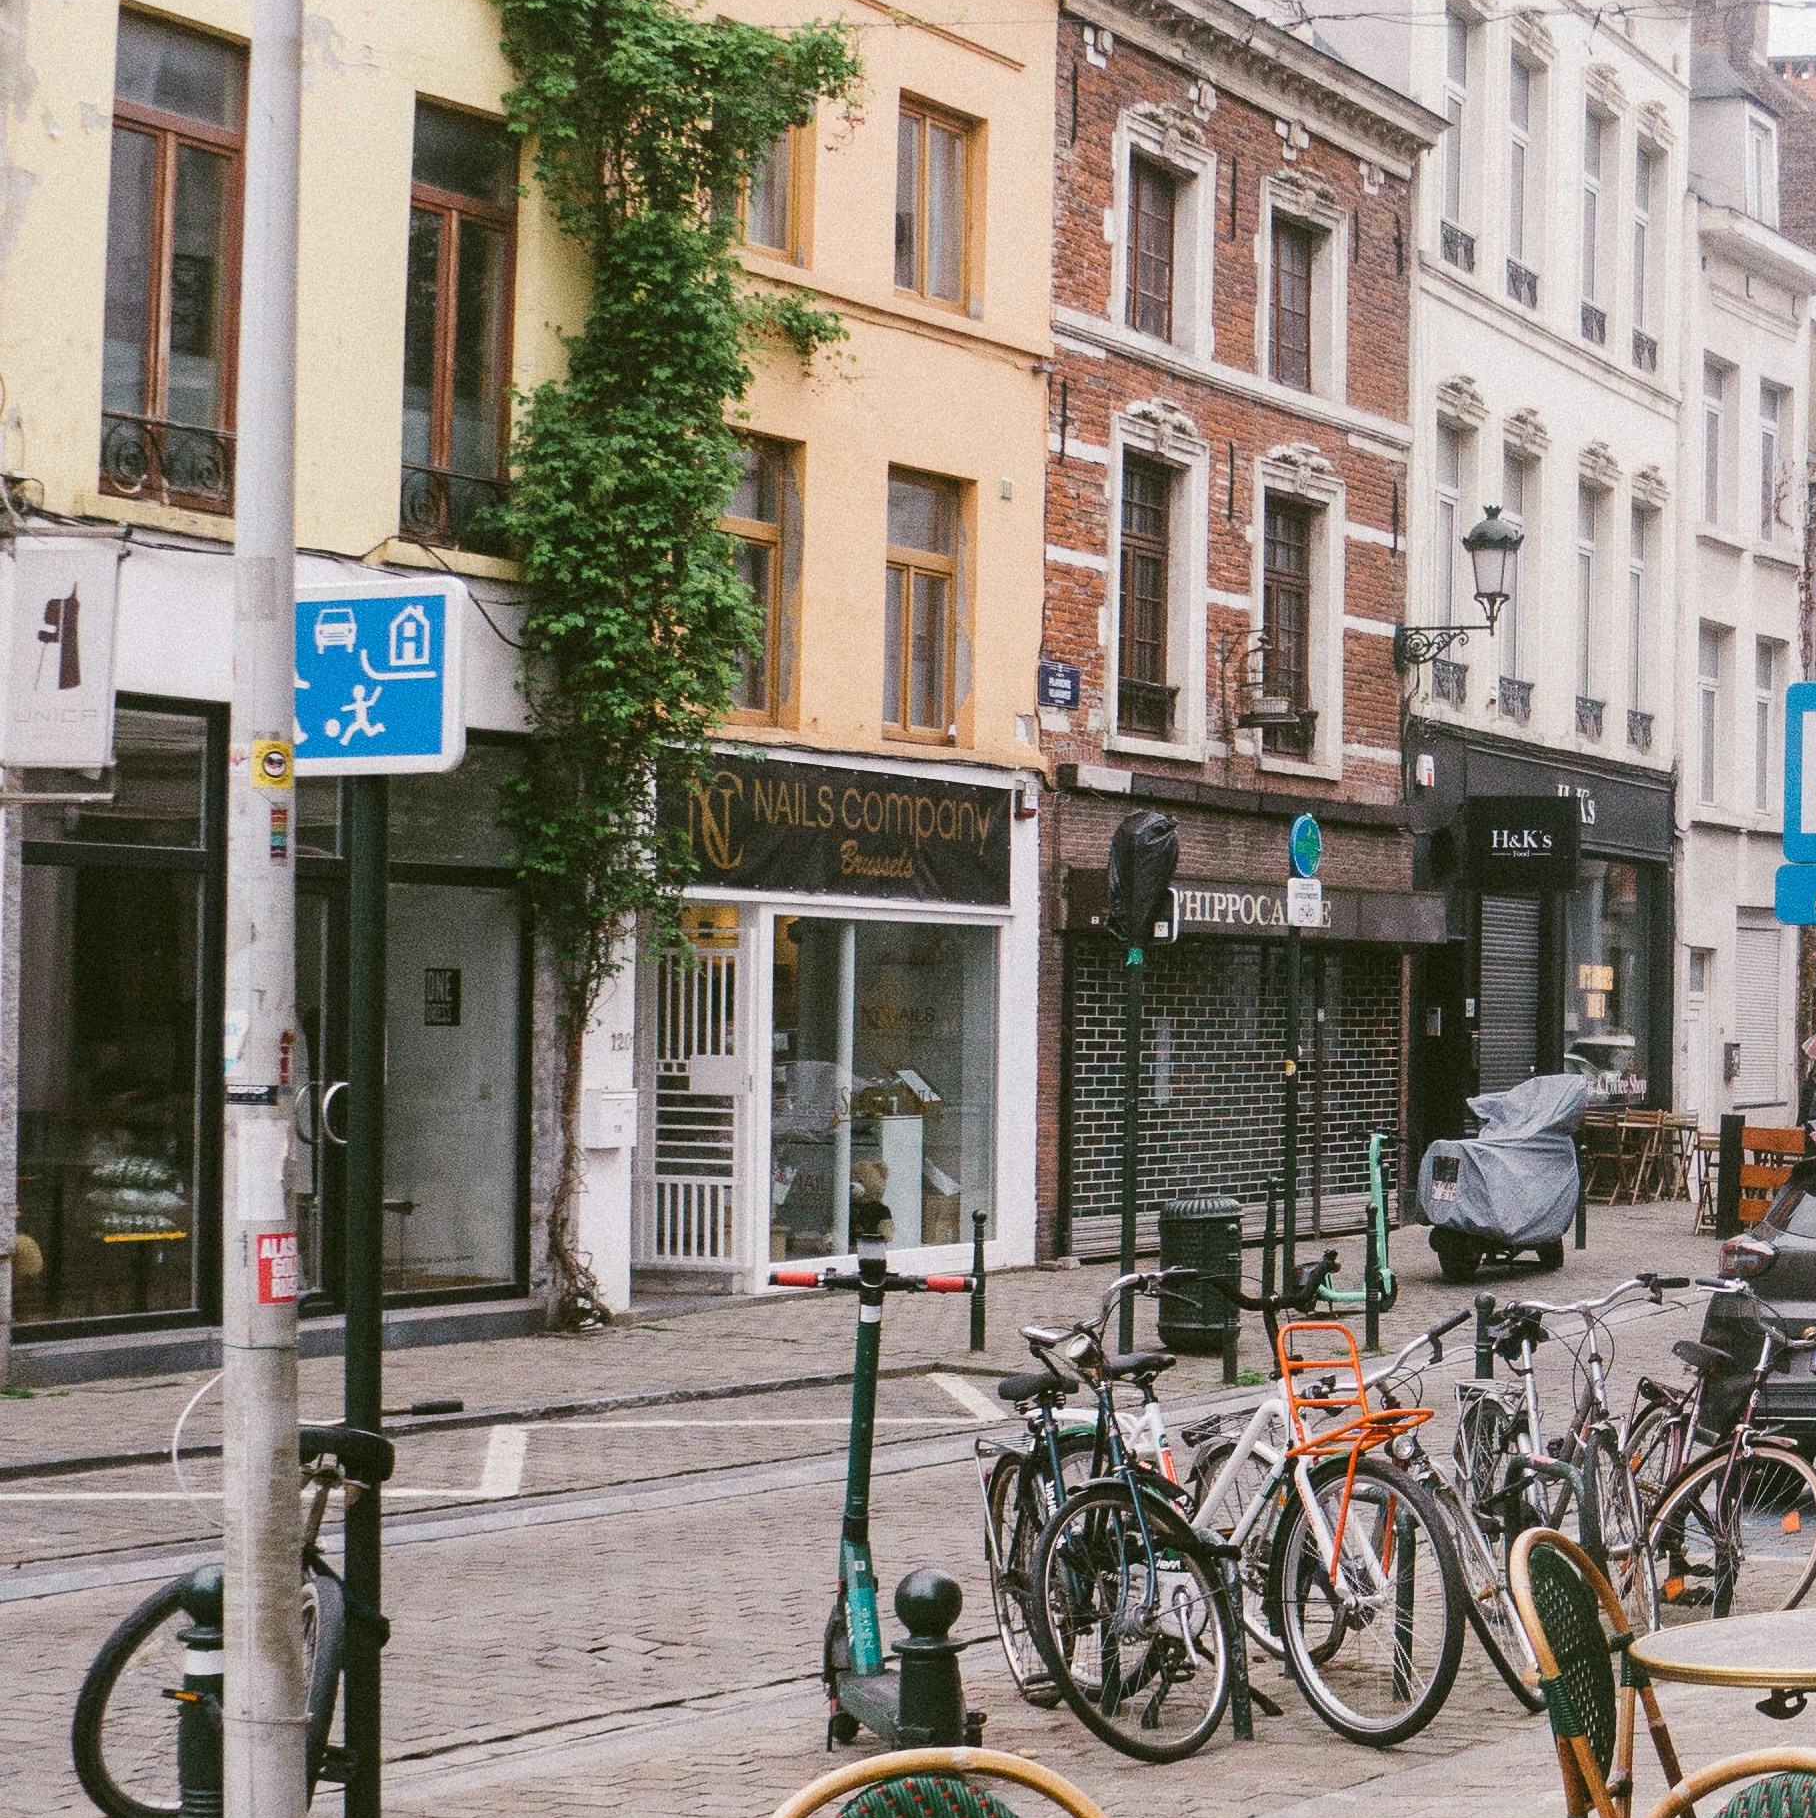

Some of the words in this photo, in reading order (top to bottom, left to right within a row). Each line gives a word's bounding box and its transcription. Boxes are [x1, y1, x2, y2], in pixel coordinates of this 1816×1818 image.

[754, 779, 835, 829] NAILS
[1491, 829, 1553, 848] H&K's
[839, 839, 914, 879] Brussels
